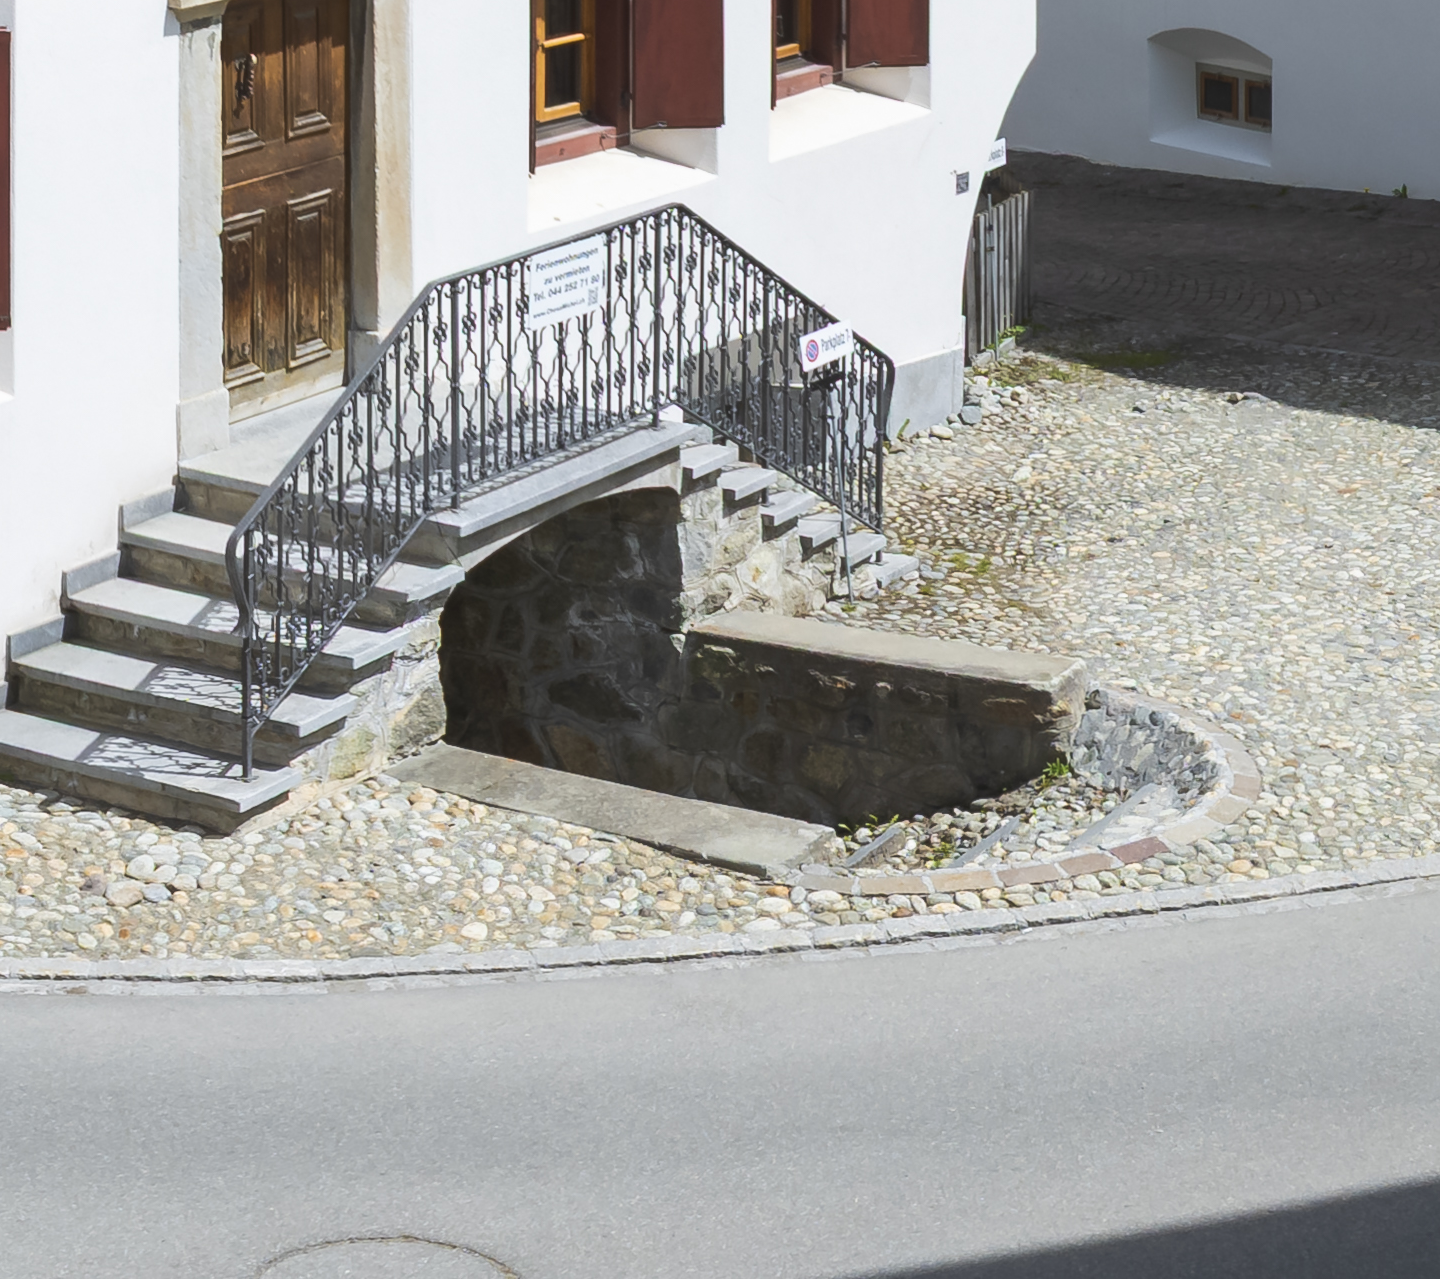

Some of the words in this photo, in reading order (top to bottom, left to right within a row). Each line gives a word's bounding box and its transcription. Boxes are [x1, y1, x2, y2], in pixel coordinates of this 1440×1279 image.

[536, 248, 598, 272] Ferienwohnungen
[544, 277, 553, 286] zu
[555, 266, 590, 281] vermieten
[534, 291, 546, 302] Tel.
[548, 286, 562, 297] 044
[565, 281, 578, 292] 252
[580, 278, 588, 287] 71
[821, 332, 845, 352] Parkplatz
